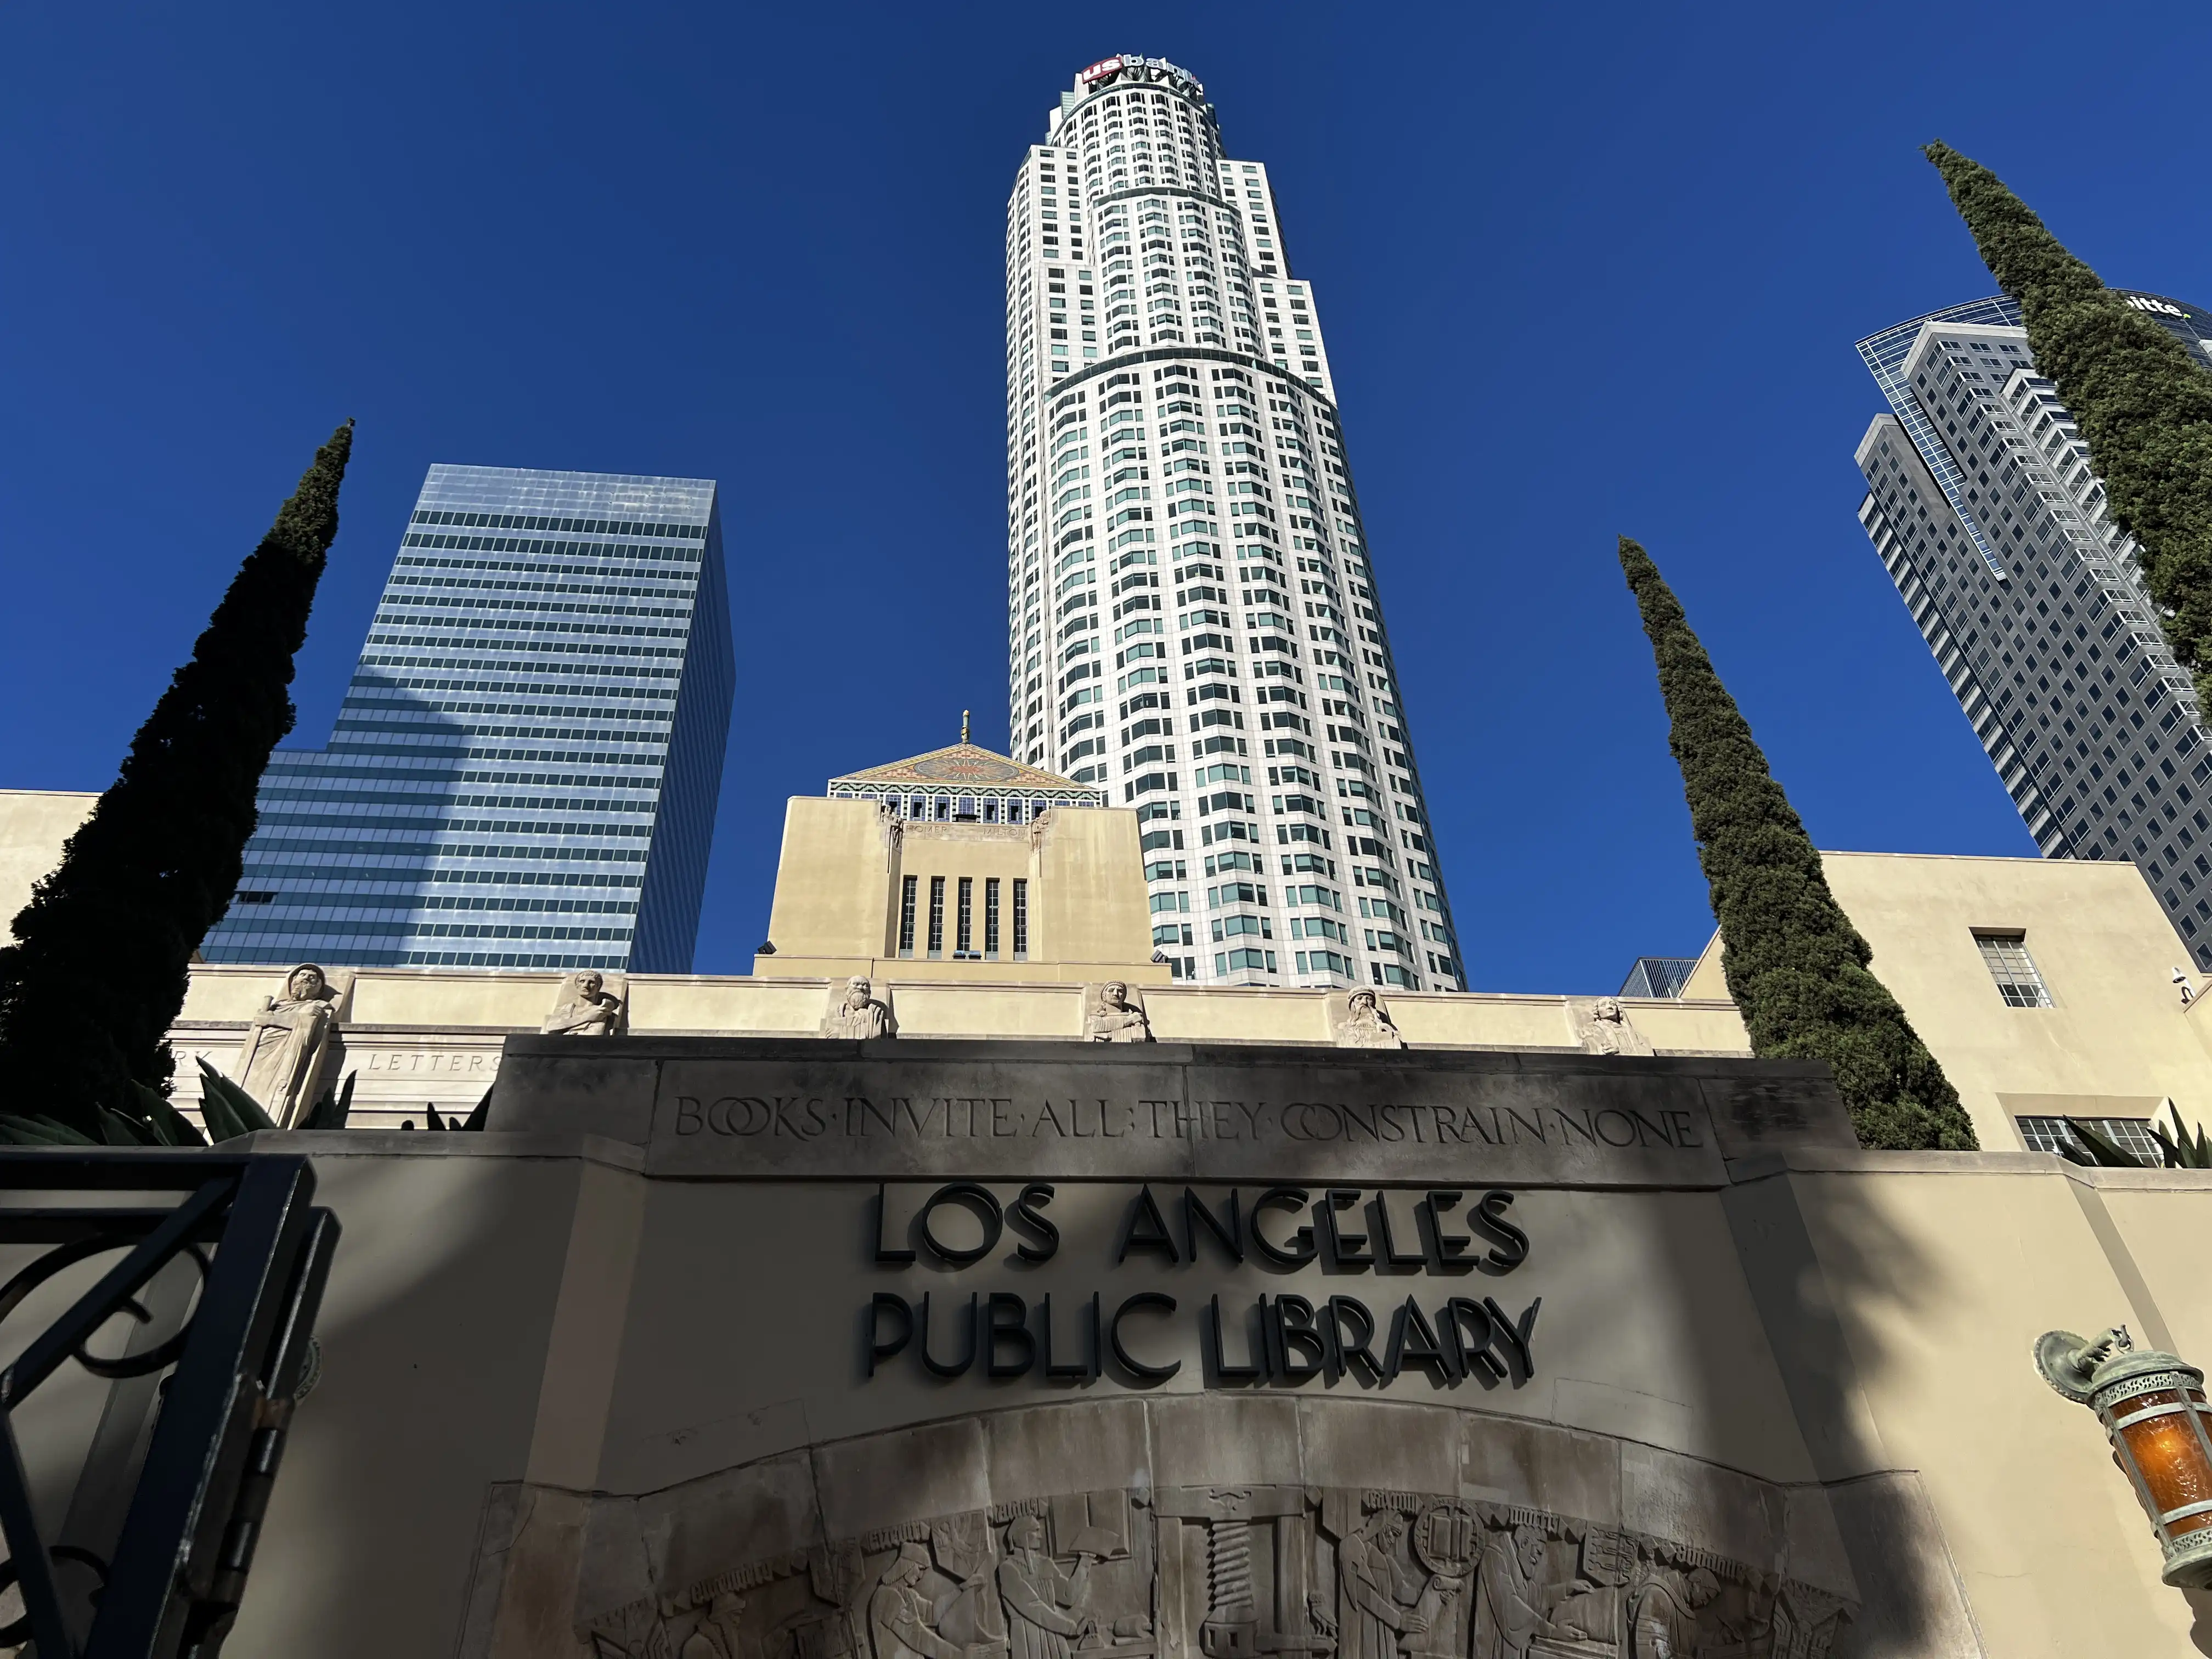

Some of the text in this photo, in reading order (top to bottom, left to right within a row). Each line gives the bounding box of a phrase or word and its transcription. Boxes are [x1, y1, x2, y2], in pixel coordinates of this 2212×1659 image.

[905, 825, 947, 833] HOMER
[983, 827, 1026, 836] MILTON
[368, 1054, 501, 1071] LETTERS
[674, 1096, 826, 1142] BOOKS
[844, 1097, 1018, 1137] INVITE
[1138, 1099, 1267, 1141] THEY
[1280, 1102, 1548, 1145] CONSTRAIN
[1554, 1109, 1703, 1147] NONE
[874, 1181, 1530, 1268] LOS ANGELES
[868, 1290, 1542, 1379] PUBLIC LIBRARY
